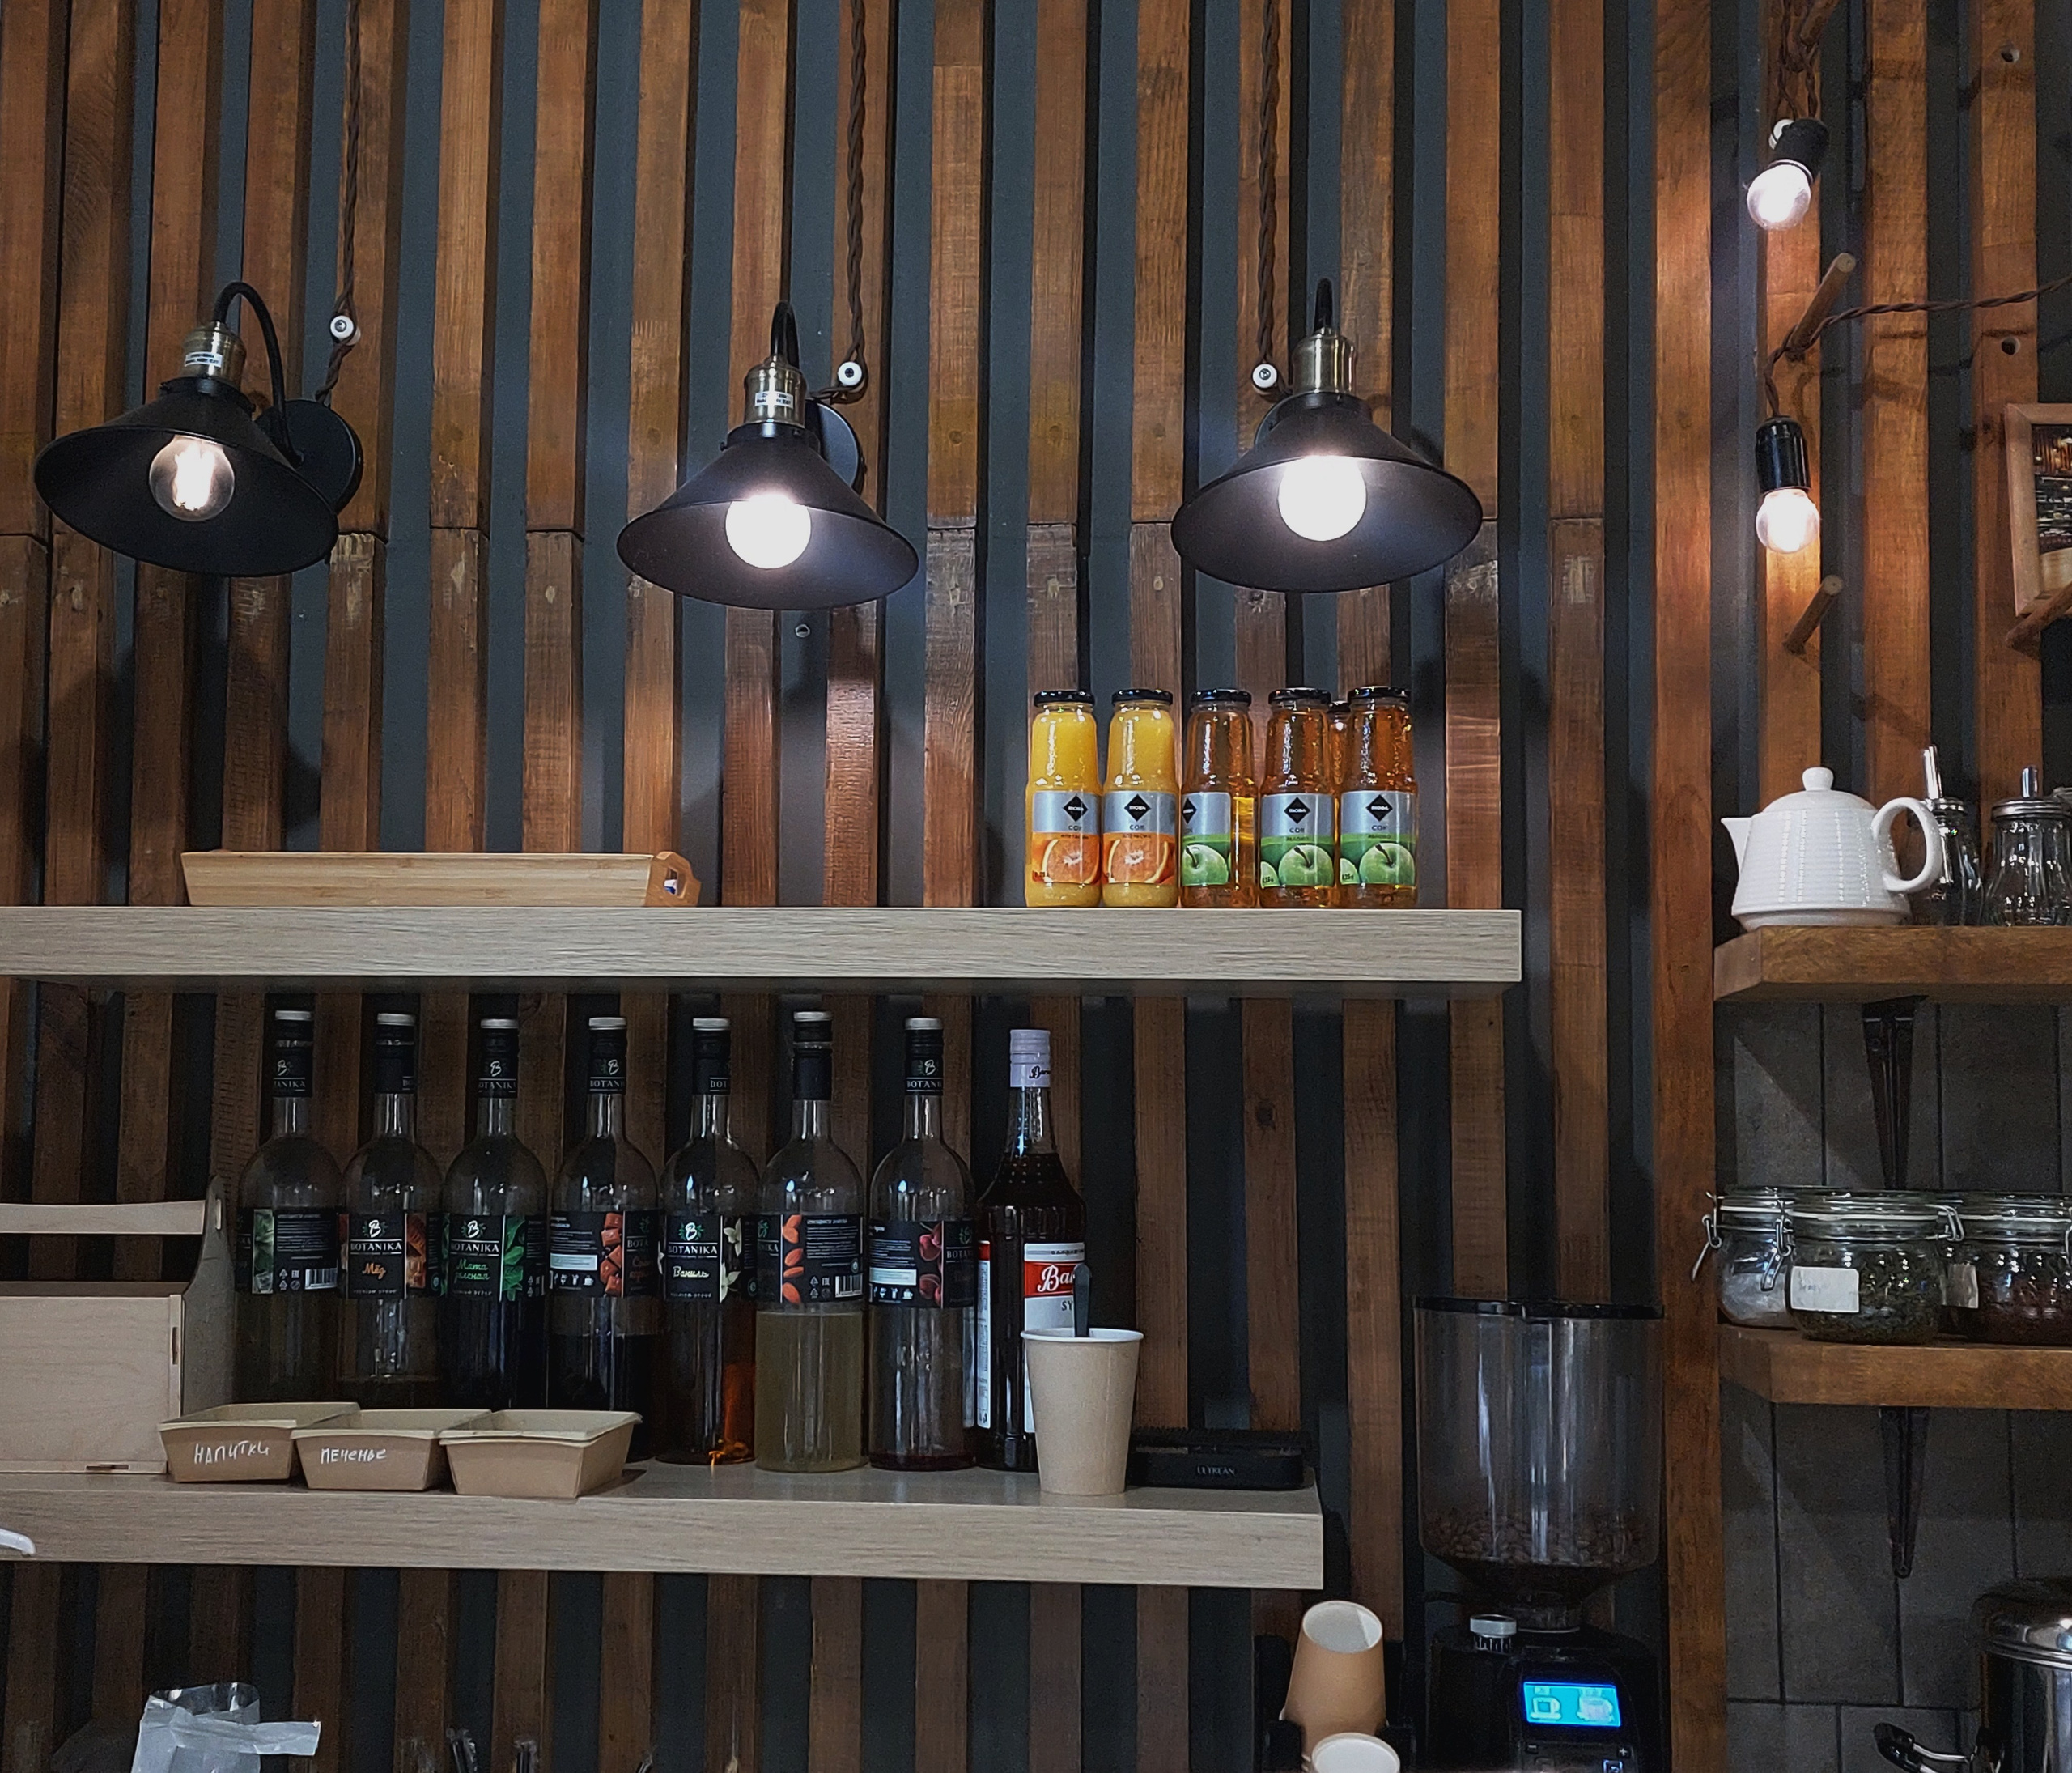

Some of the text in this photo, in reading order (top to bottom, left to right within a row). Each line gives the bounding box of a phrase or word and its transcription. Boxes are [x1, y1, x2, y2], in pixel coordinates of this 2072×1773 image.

[350, 1242, 402, 1252] BOTANIKA
[668, 1245, 718, 1254] BOTANIKA
[194, 1440, 269, 1465] НАПИТКИ
